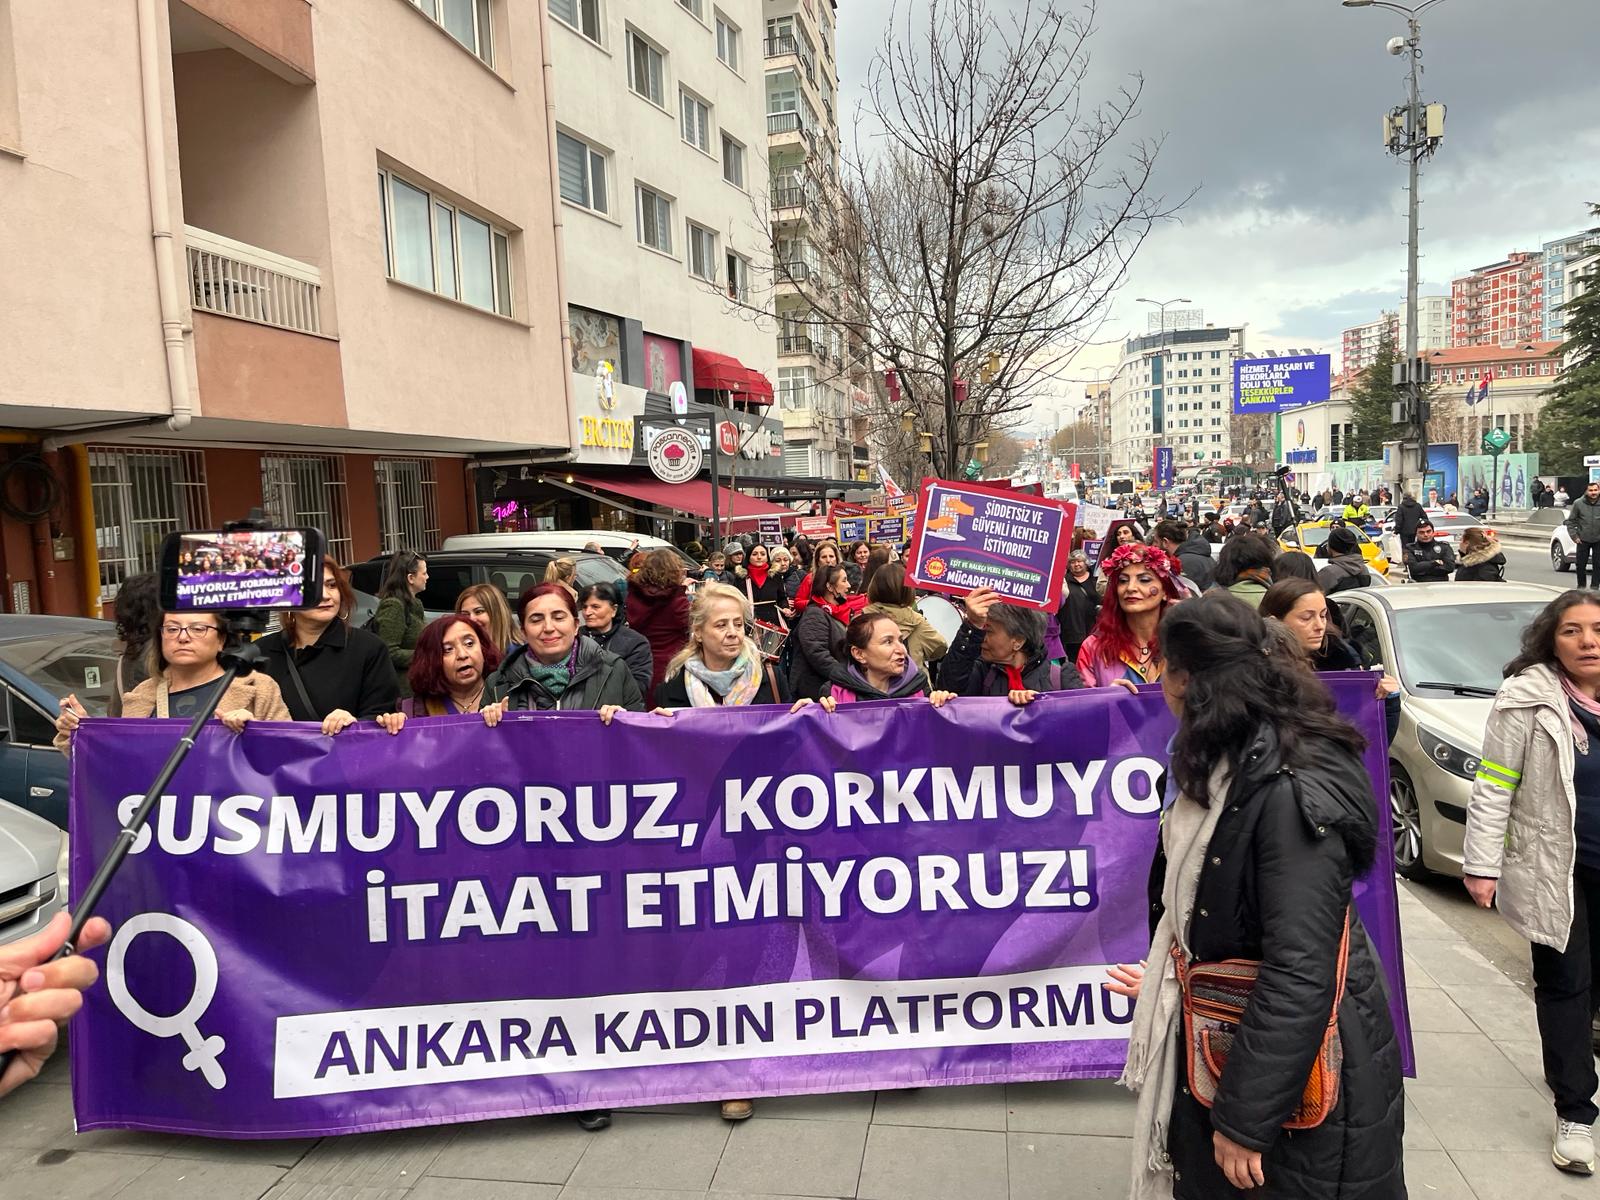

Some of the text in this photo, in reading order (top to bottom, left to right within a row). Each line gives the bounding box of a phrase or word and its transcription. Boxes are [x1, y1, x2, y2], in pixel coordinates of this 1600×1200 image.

[1239, 371, 1290, 382] REKORLARLA
[1303, 361, 1315, 370] VE
[1239, 381, 1260, 389] DOLU
[1272, 379, 1285, 388] YIL
[1239, 395, 1276, 407] ÇANKAYA
[985, 500, 1044, 525] ŞİDDETSİZ VE
[971, 516, 1049, 544] GÜVENLİ KENTLER
[983, 533, 1032, 559] İSTİYORUZ!
[946, 570, 1033, 598] MÜCADELEMİZ VAR!
[192, 588, 283, 606] İTAAT ETMİYORUZ!
[117, 782, 699, 855] SUSMUYORUZ,
[366, 847, 1092, 943] İTAAT ETMİYORUZ!
[314, 982, 1138, 1080] ANKARA KADIN PLATFORMU
